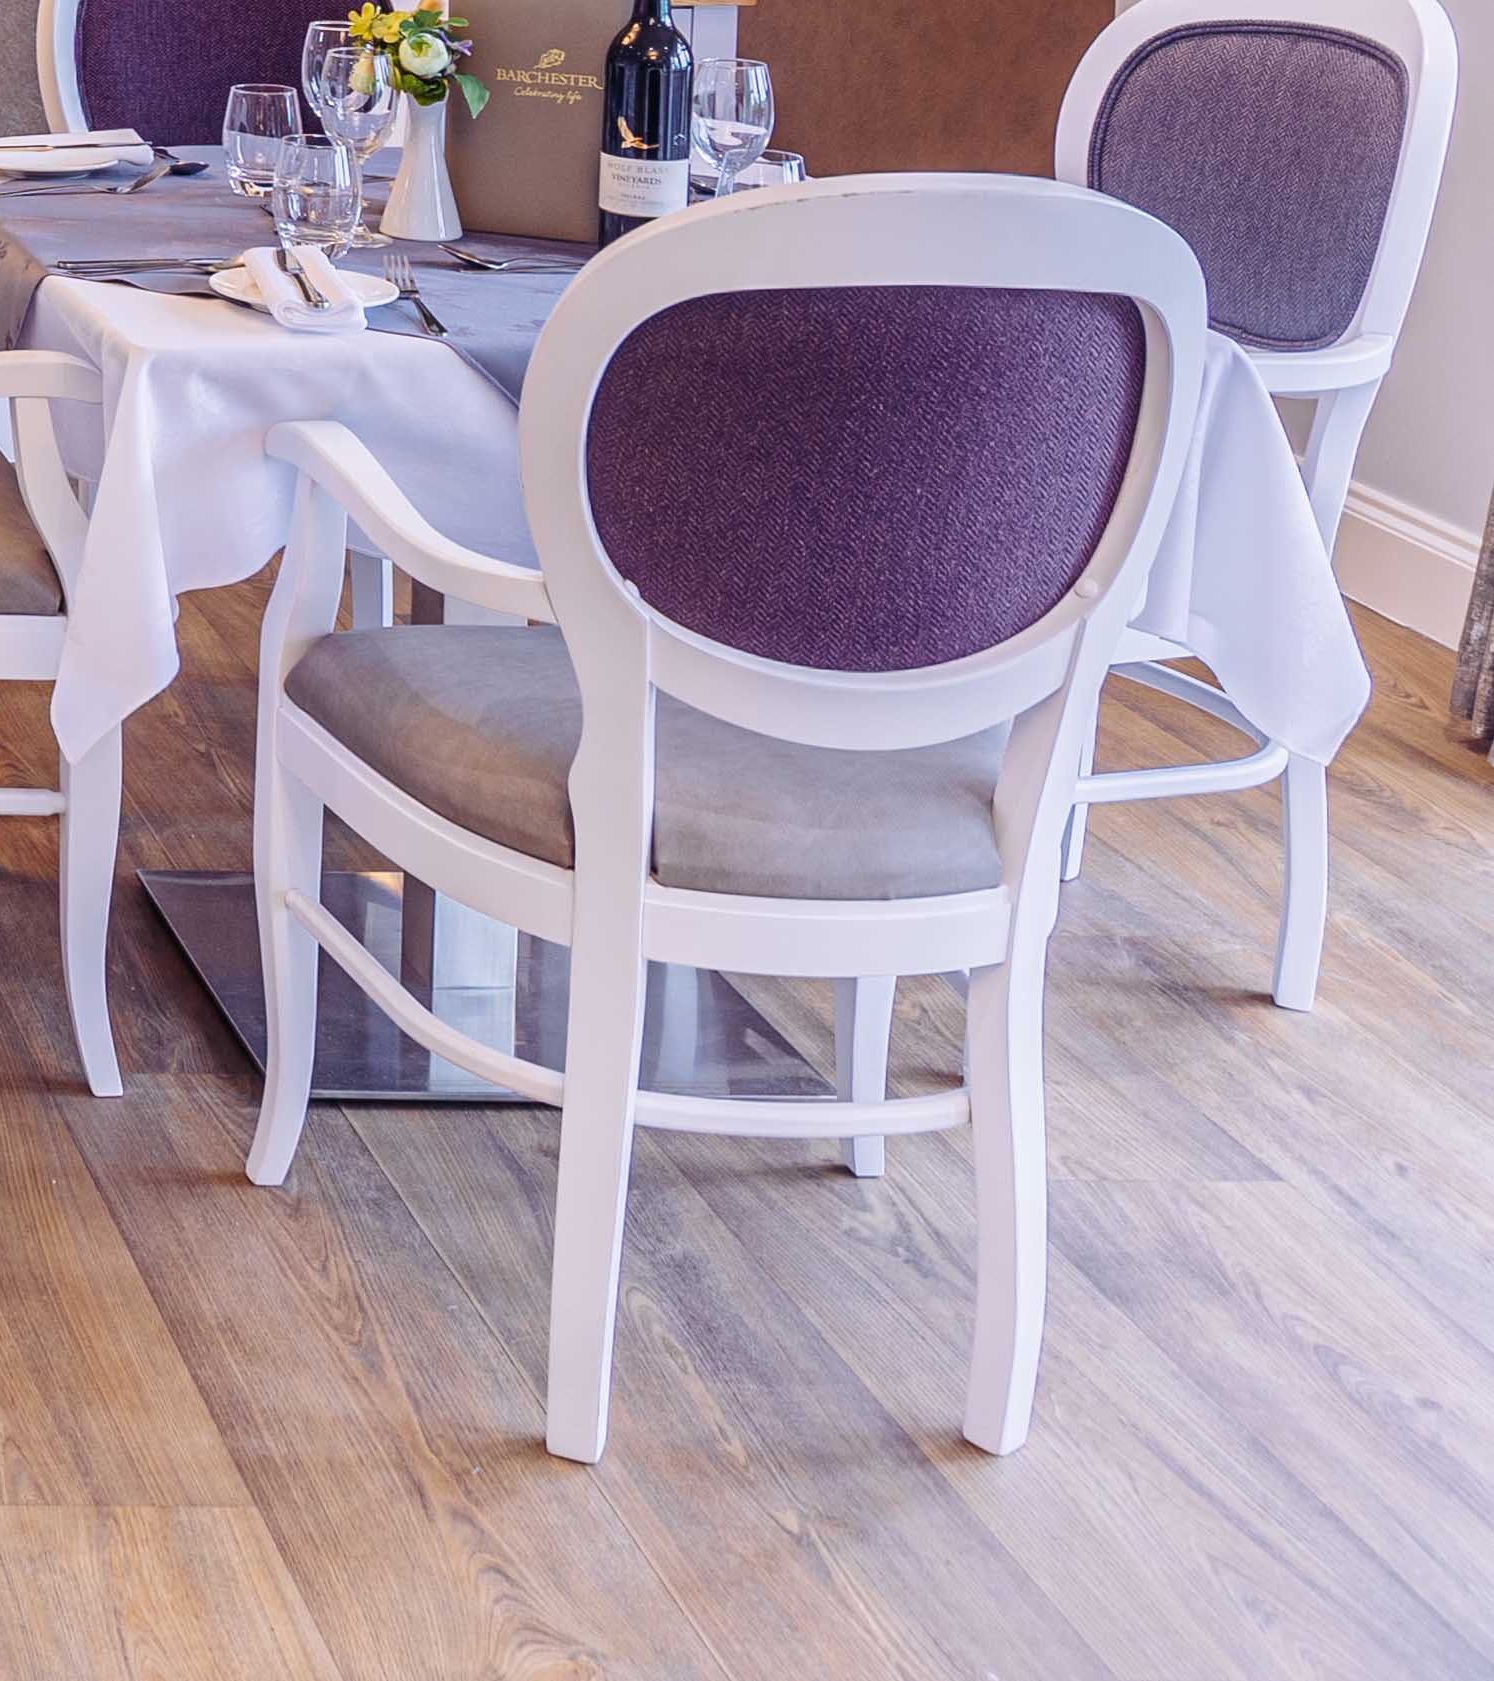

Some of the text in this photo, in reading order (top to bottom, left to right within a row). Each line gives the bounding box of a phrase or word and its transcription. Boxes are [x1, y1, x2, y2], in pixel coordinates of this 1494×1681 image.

[496, 68, 605, 90] BARCHESTER
[514, 86, 582, 105] Celebrating life
[612, 173, 662, 185] VINEYARDS
